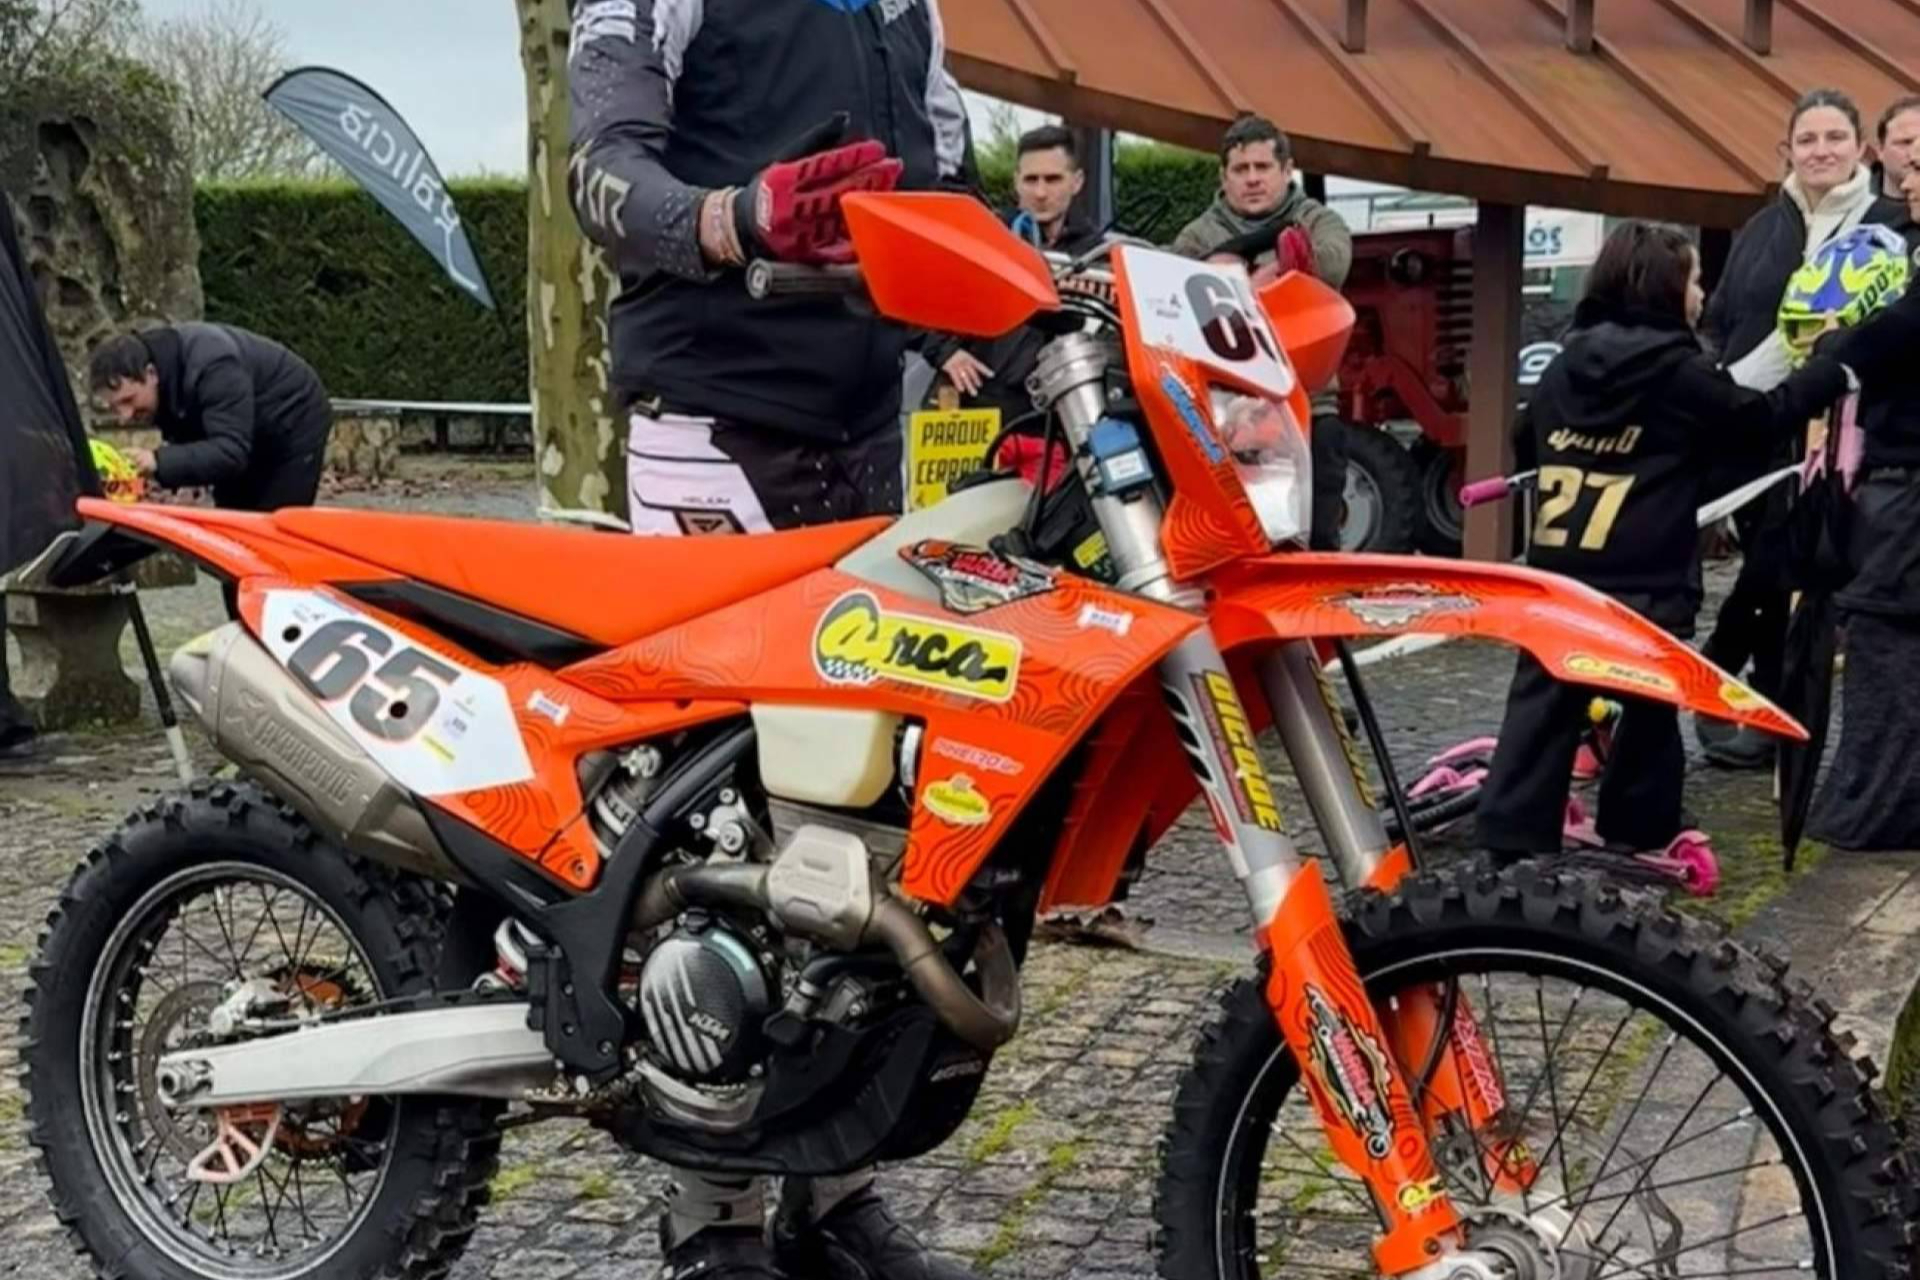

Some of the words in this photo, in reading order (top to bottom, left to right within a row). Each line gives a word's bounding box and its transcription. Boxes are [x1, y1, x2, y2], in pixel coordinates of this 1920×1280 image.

[921, 419, 991, 447] PARQUE
[1533, 465, 1636, 549] 27
[287, 619, 462, 742] 65
